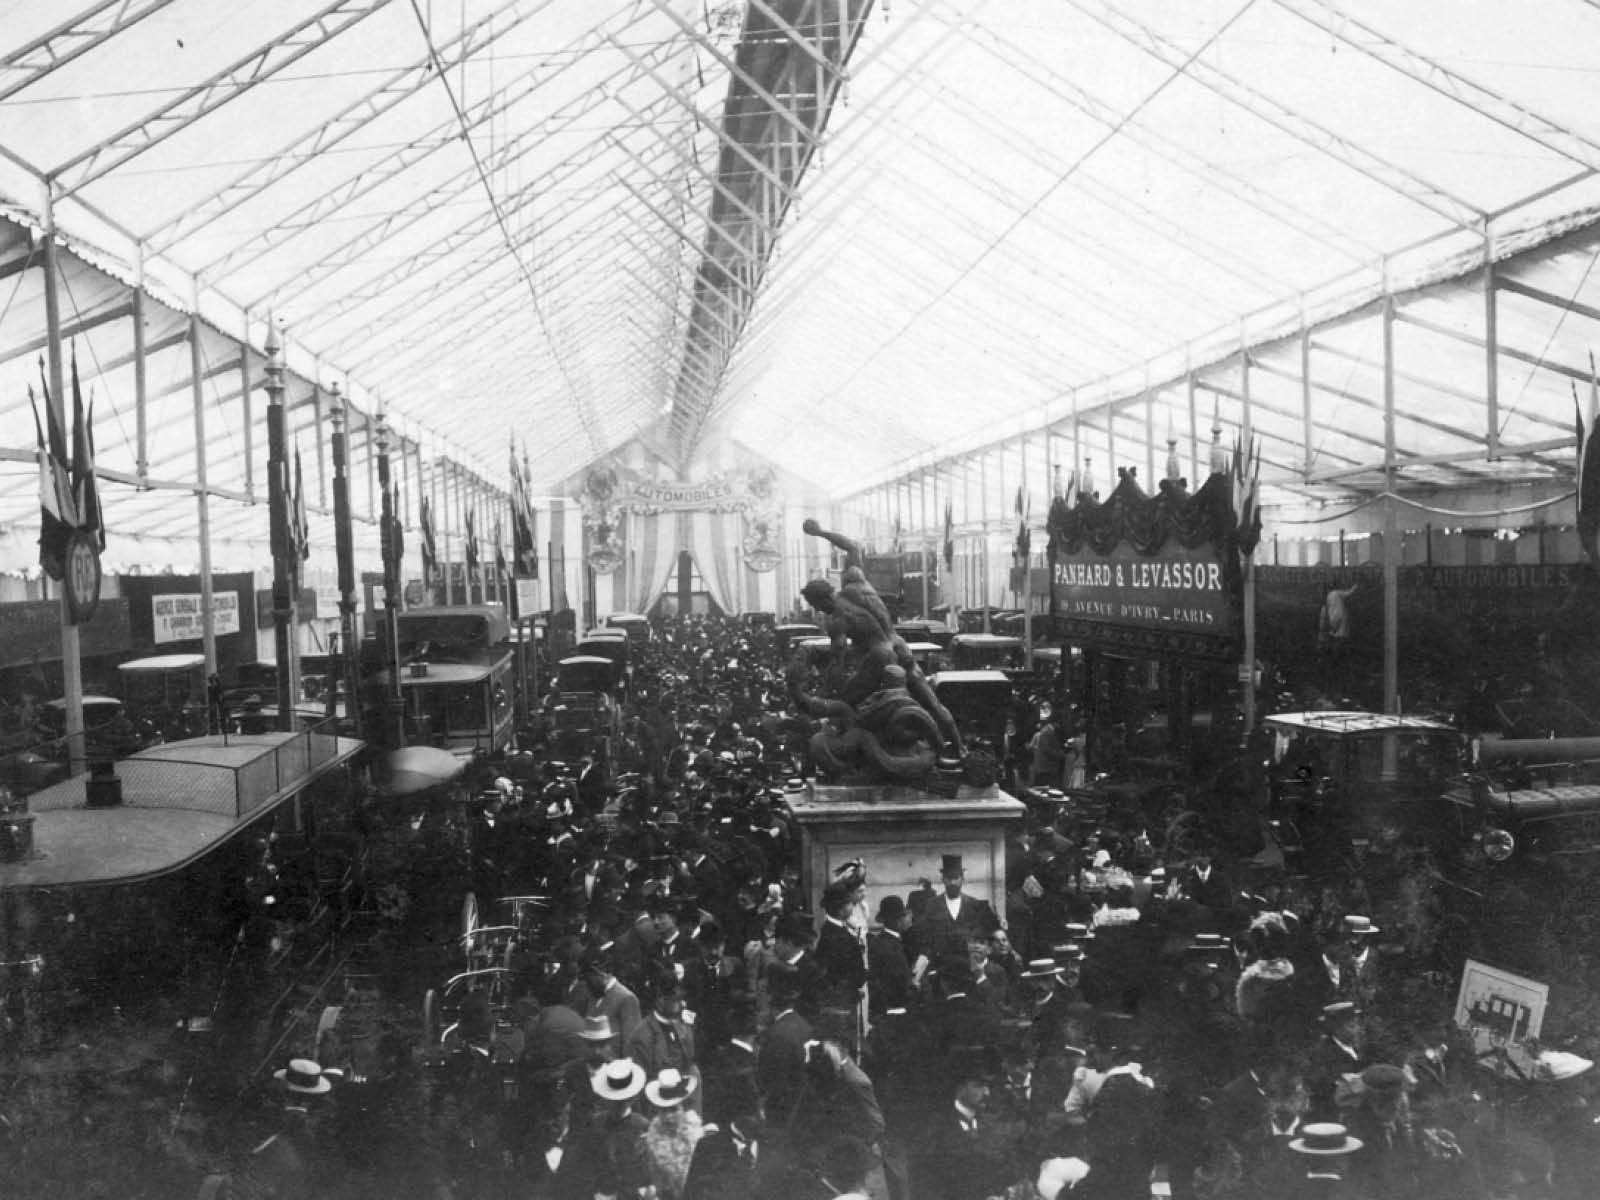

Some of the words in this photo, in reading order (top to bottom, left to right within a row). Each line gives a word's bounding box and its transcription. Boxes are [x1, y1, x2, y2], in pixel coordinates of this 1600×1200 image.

[634, 483, 732, 502] AUTOMOBILES
[1055, 563, 1111, 586] PANHARD
[1116, 564, 1125, 587] &
[1132, 563, 1222, 591] LEVASSOR
[1076, 600, 1113, 616] AVENUE
[1120, 603, 1161, 620] D'IVRY
[1173, 607, 1214, 625] PARIS
